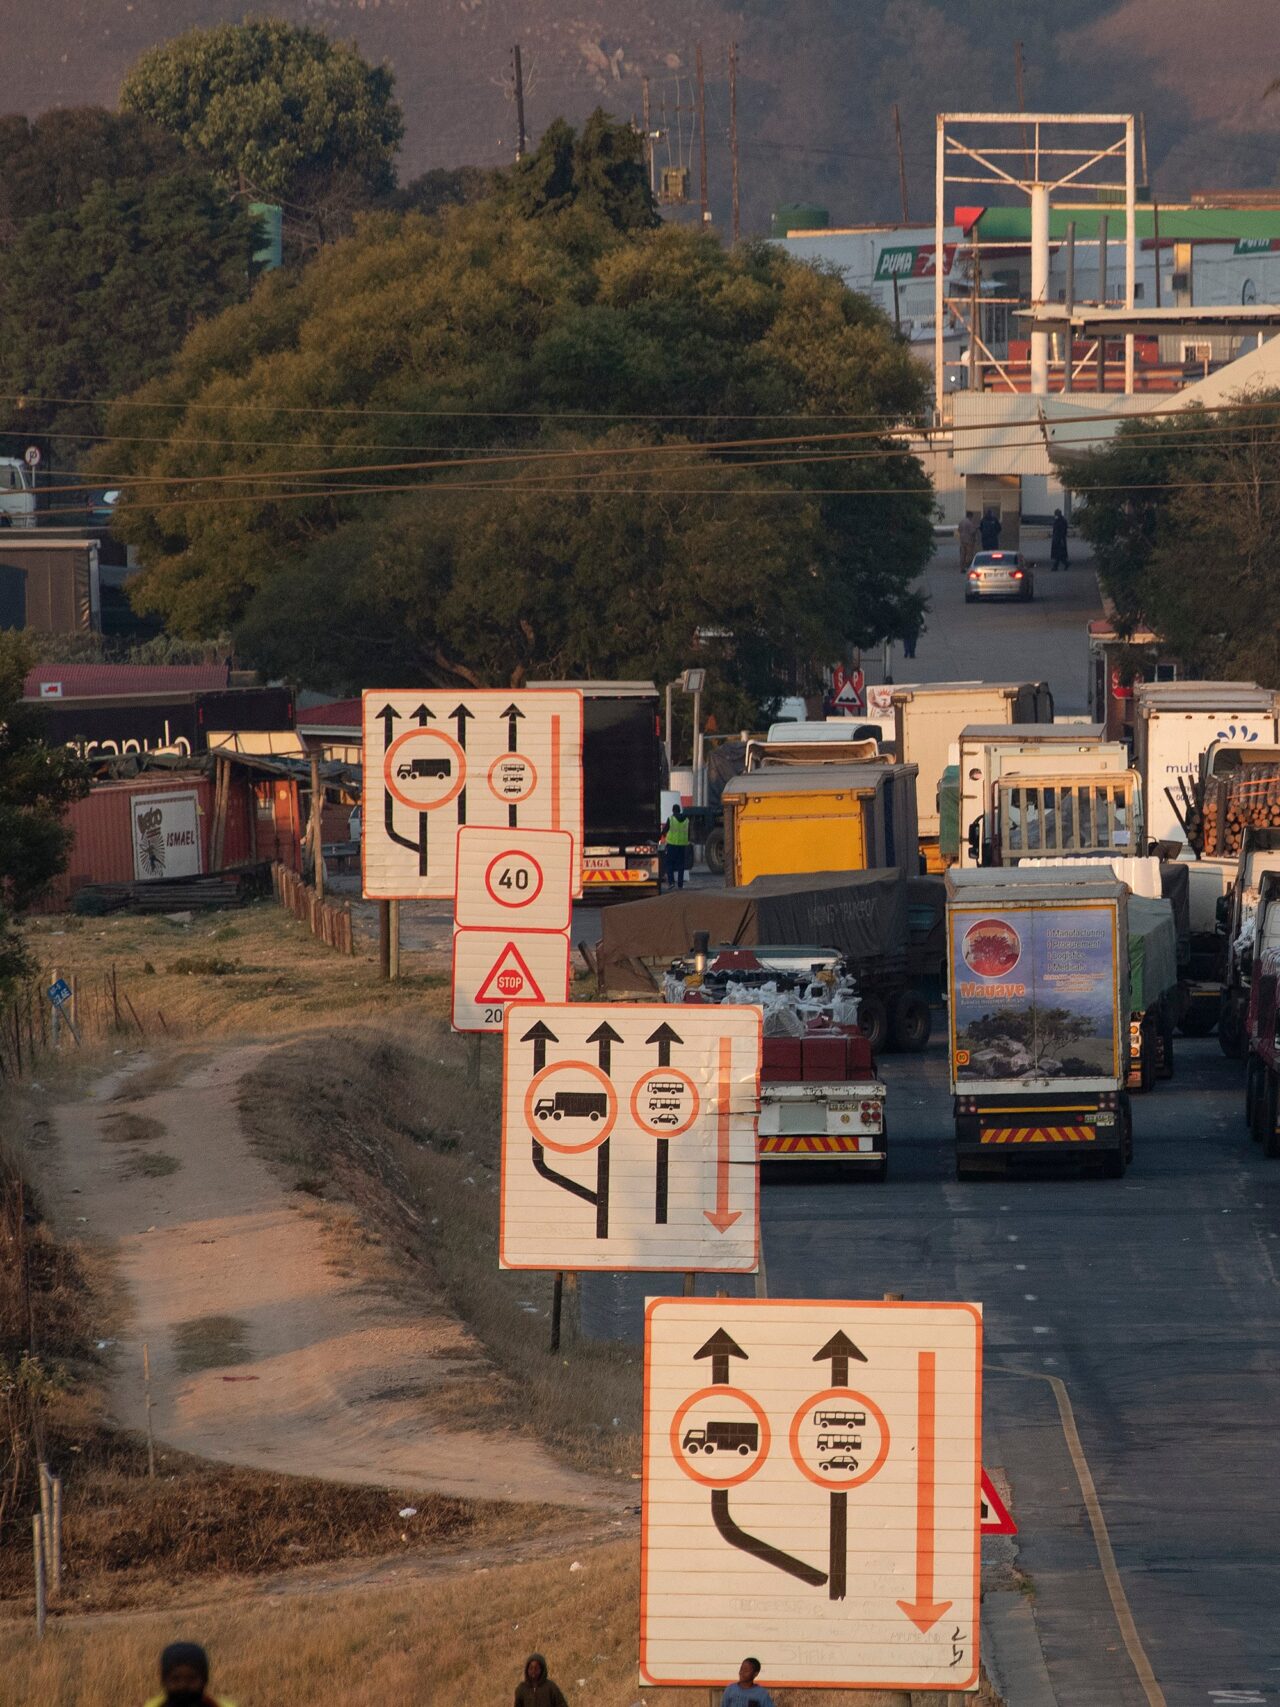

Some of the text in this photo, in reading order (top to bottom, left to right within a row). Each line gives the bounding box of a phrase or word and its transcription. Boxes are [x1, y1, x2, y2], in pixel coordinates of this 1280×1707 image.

[880, 251, 912, 274] PUMA
[166, 830, 195, 847] ISMAEL
[498, 868, 529, 890] 40
[498, 976, 522, 987] STOP
